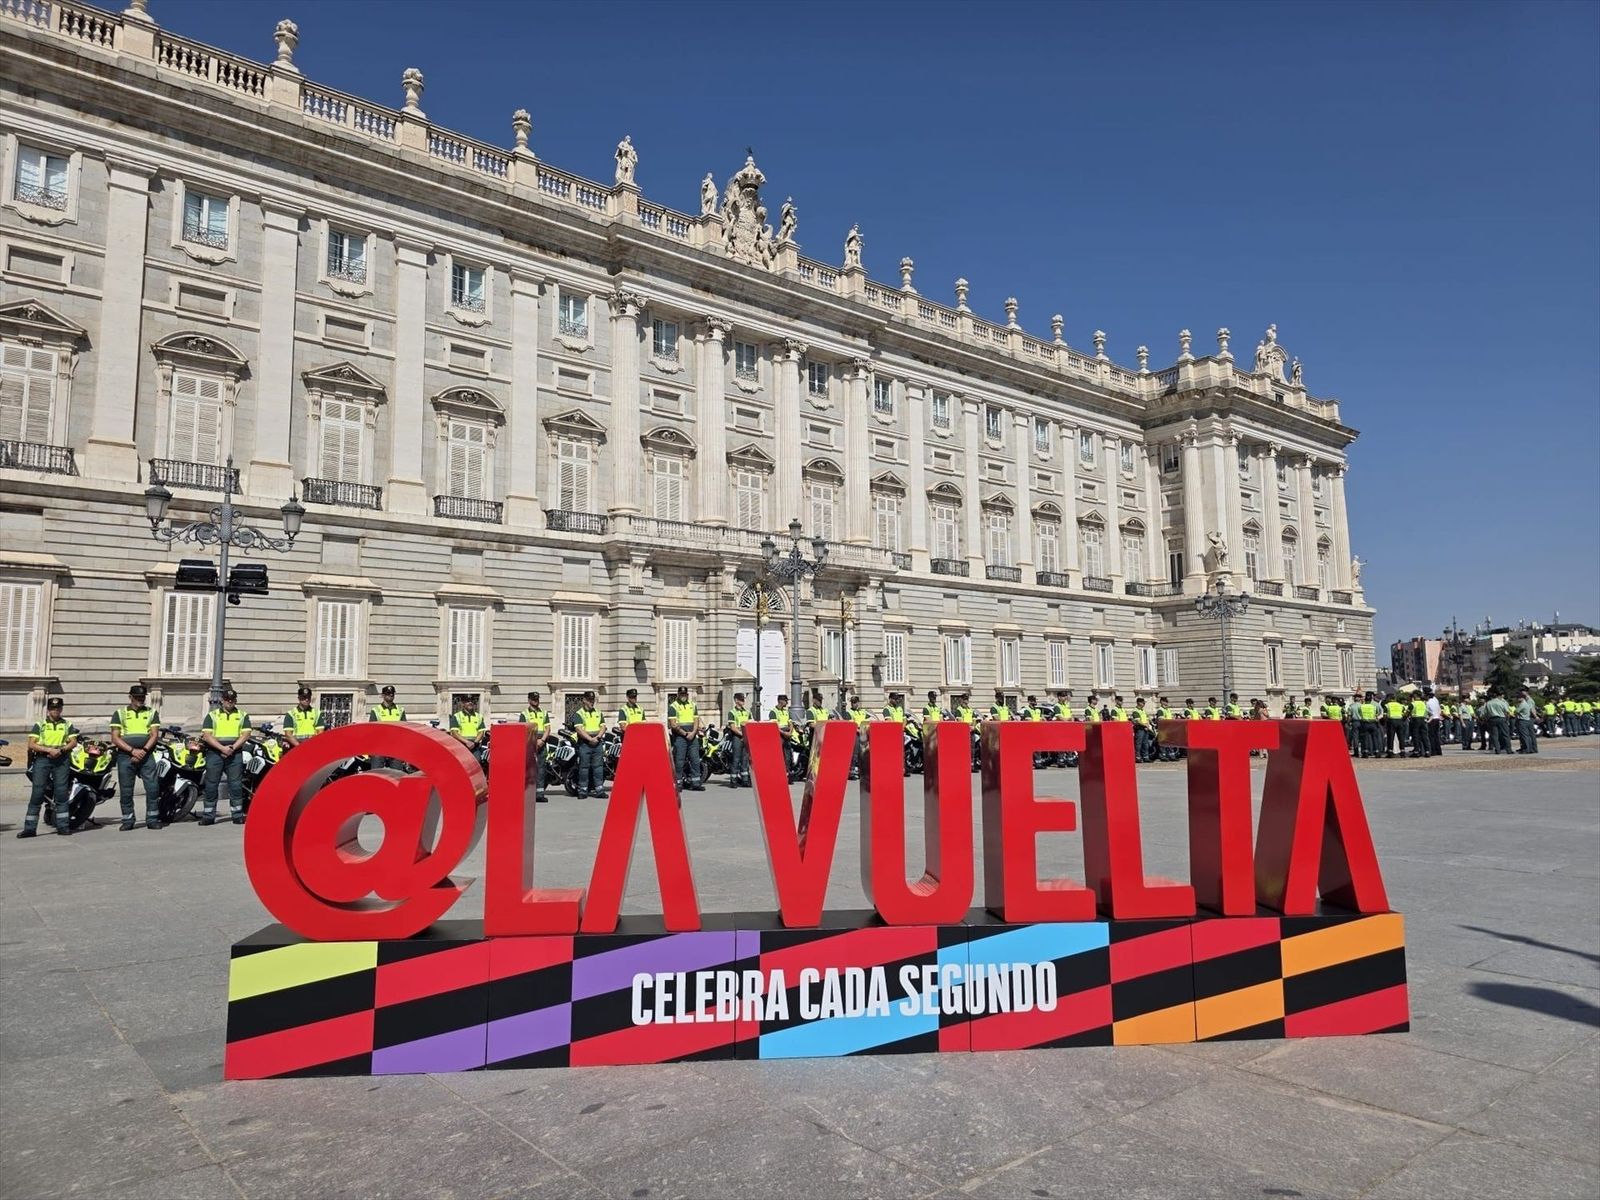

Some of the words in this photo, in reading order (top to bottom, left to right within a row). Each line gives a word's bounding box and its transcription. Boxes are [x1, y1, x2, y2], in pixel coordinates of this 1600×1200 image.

[631, 969, 789, 1026] CELEBRA
[799, 965, 890, 1021] CADA
[899, 961, 1057, 1016] SEGUNDO
